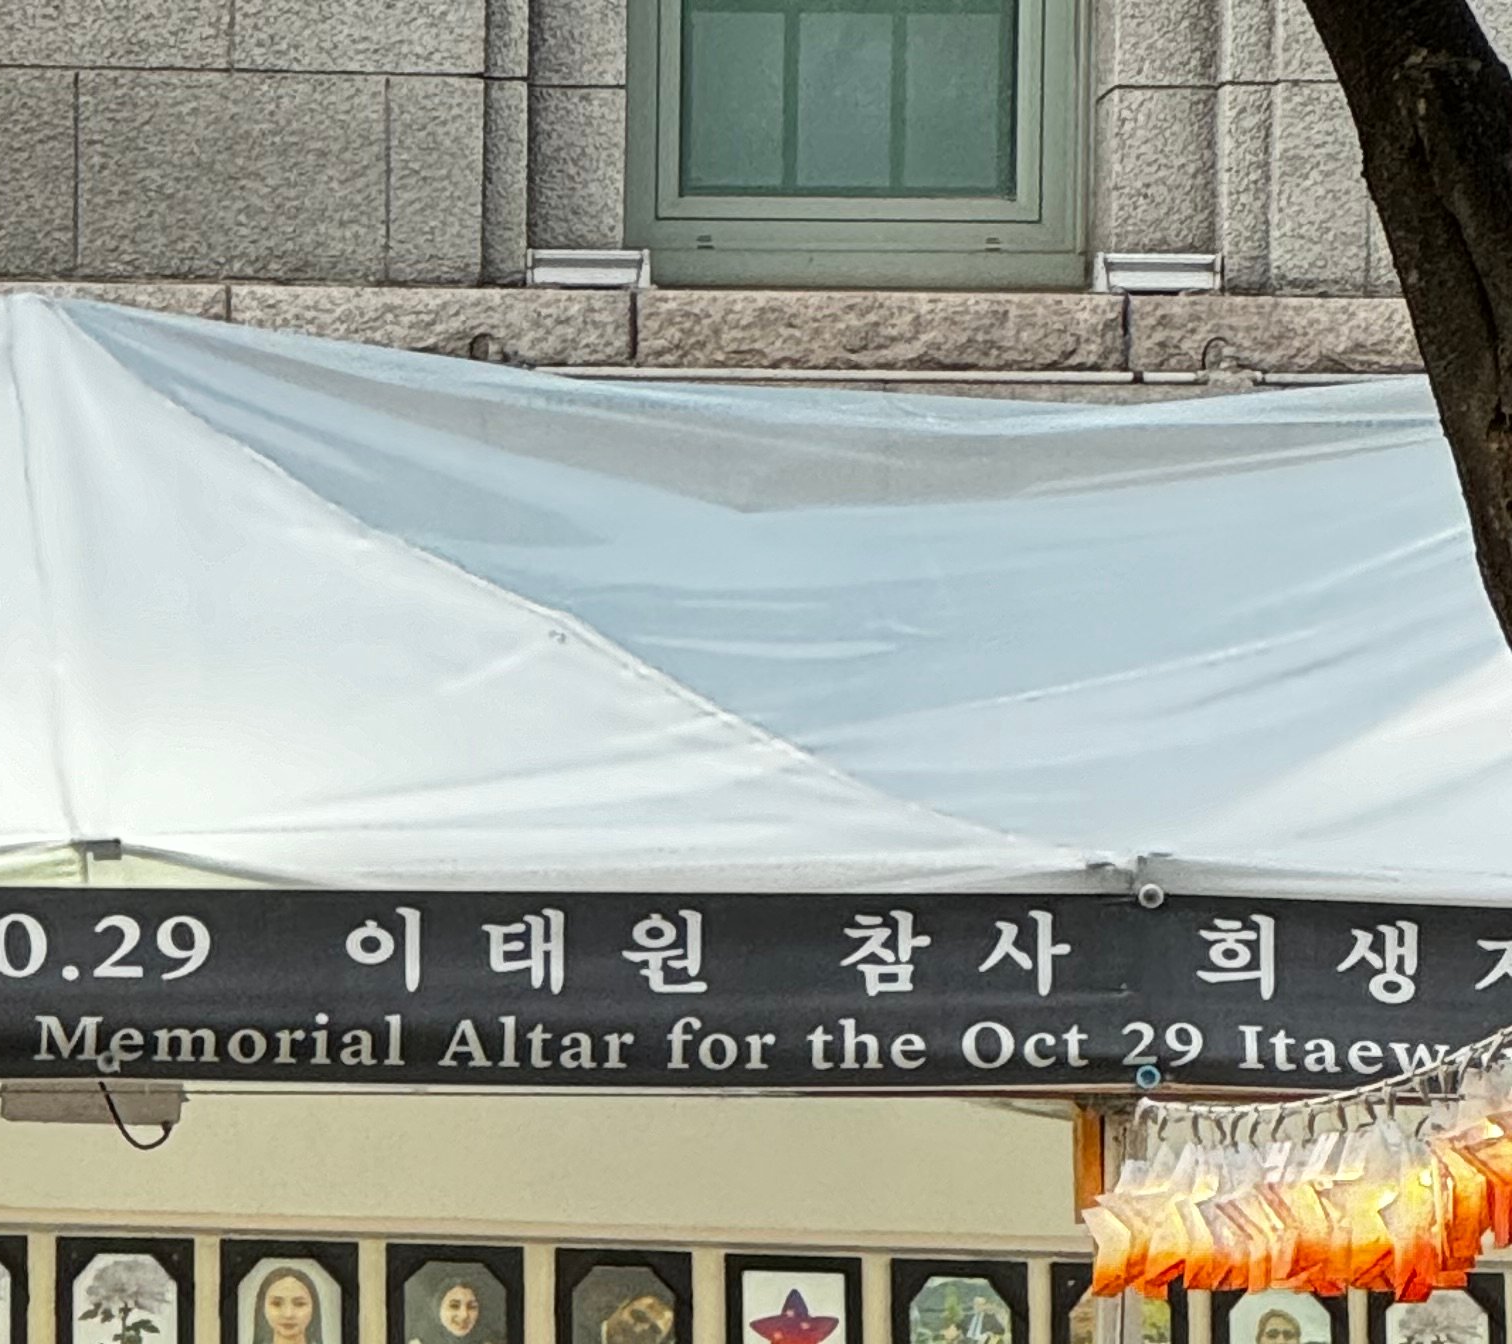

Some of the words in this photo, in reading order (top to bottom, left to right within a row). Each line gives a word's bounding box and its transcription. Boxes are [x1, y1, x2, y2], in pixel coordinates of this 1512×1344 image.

[345, 906, 708, 995] 이태원
[840, 909, 1071, 997] 참사
[33, 1012, 405, 1067] Memorial
[437, 1014, 634, 1070] Altar
[666, 1015, 775, 1071] for
[806, 1017, 926, 1070] the
[961, 1020, 1088, 1070] Oct
[1121, 1021, 1203, 1068] 29
[1238, 1024, 1512, 1078] Itaew
